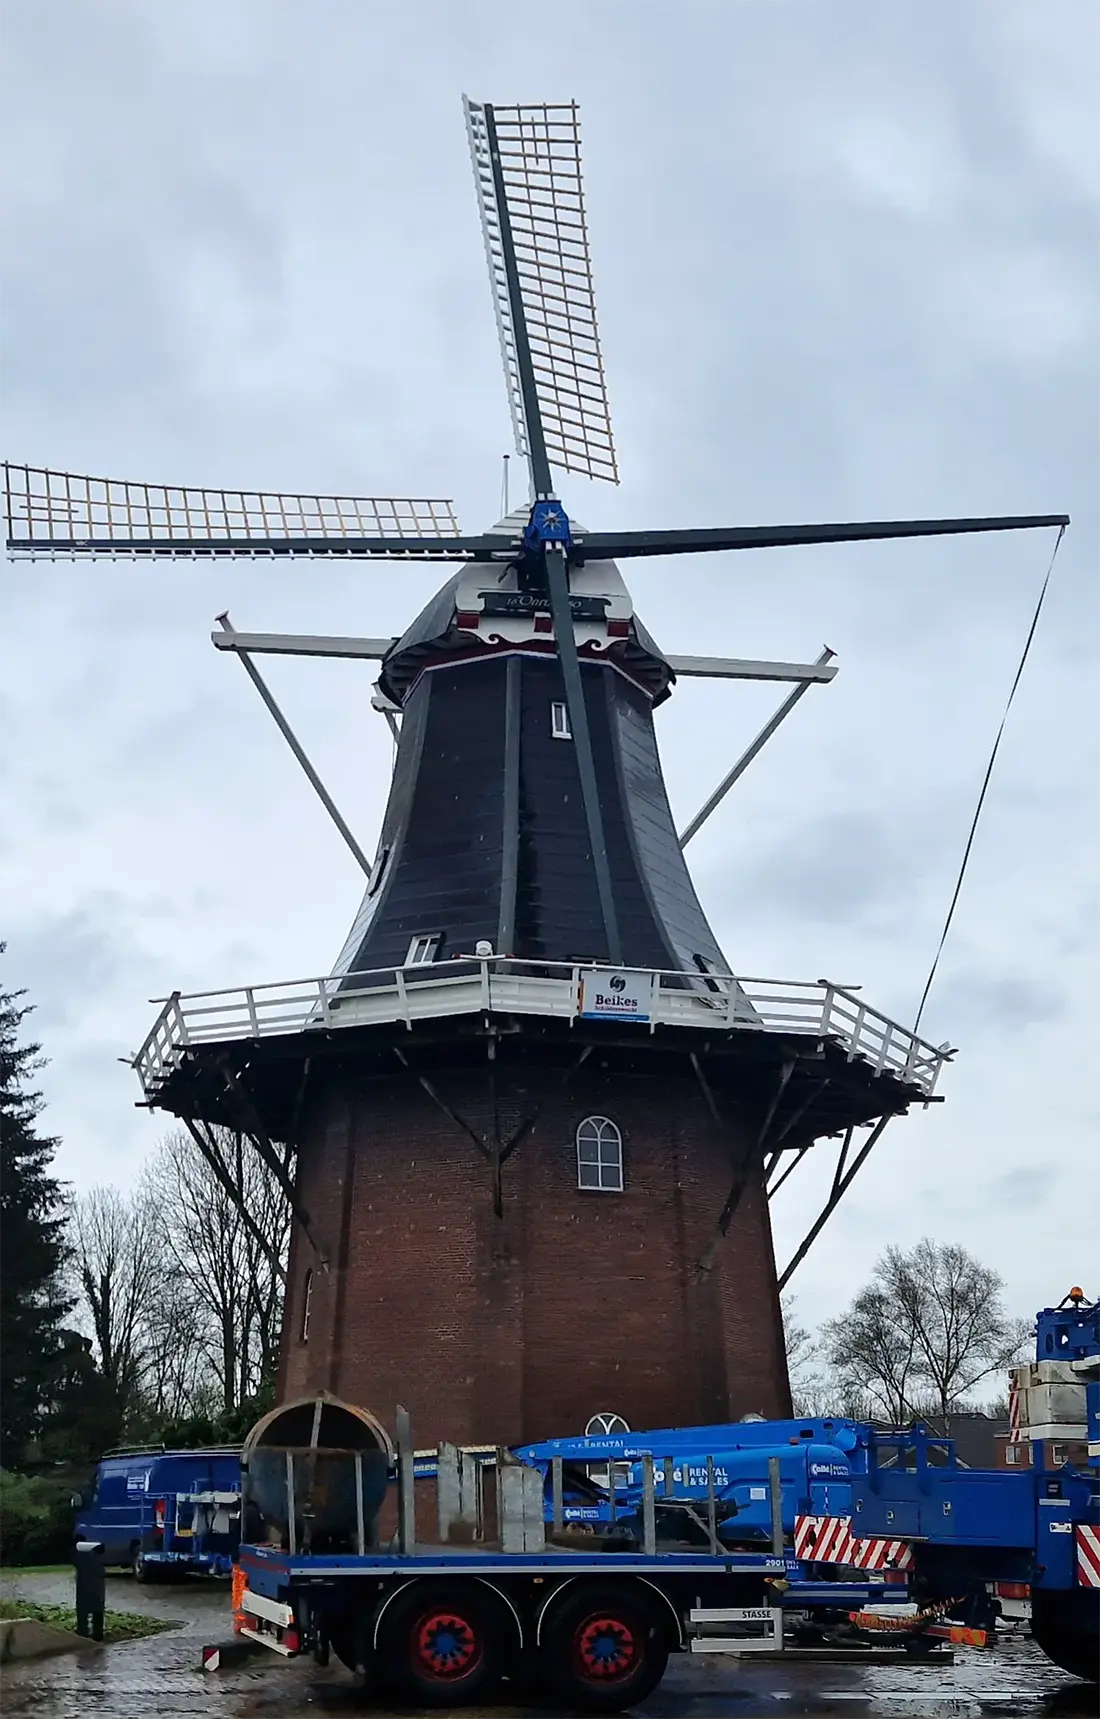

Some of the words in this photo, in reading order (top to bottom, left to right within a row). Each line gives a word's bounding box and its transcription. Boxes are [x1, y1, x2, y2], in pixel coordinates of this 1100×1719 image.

[595, 994, 638, 1007] Beikes
[689, 1467, 729, 1477] RENAL
[742, 1610, 772, 1619] STASSE
